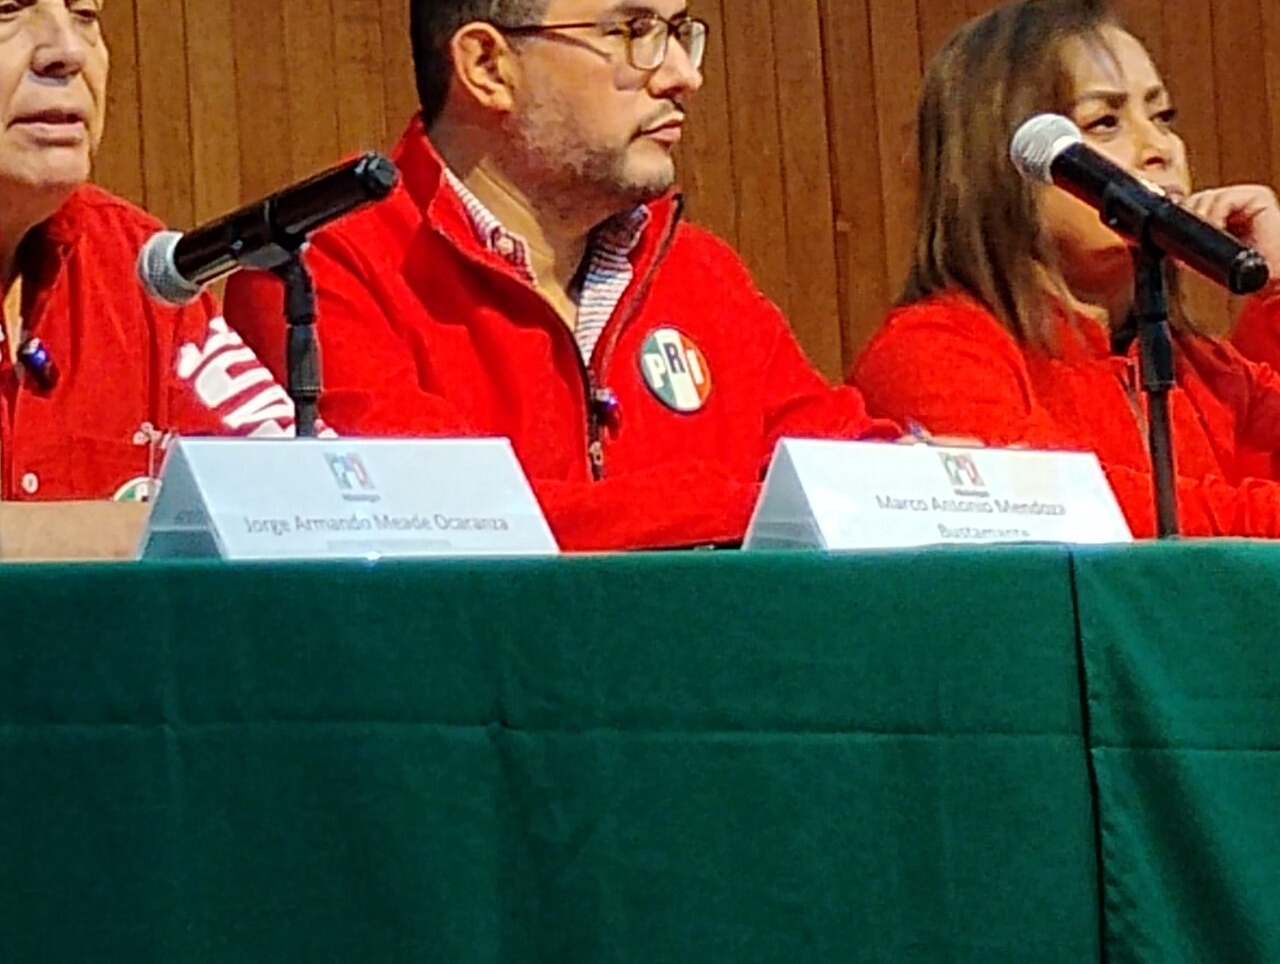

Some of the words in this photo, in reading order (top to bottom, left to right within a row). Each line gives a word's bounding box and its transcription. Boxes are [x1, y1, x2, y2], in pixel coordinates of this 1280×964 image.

[642, 341, 705, 388] PRI
[244, 516, 290, 535] Jorge
[295, 514, 371, 531] Armando
[372, 514, 432, 531] Meade
